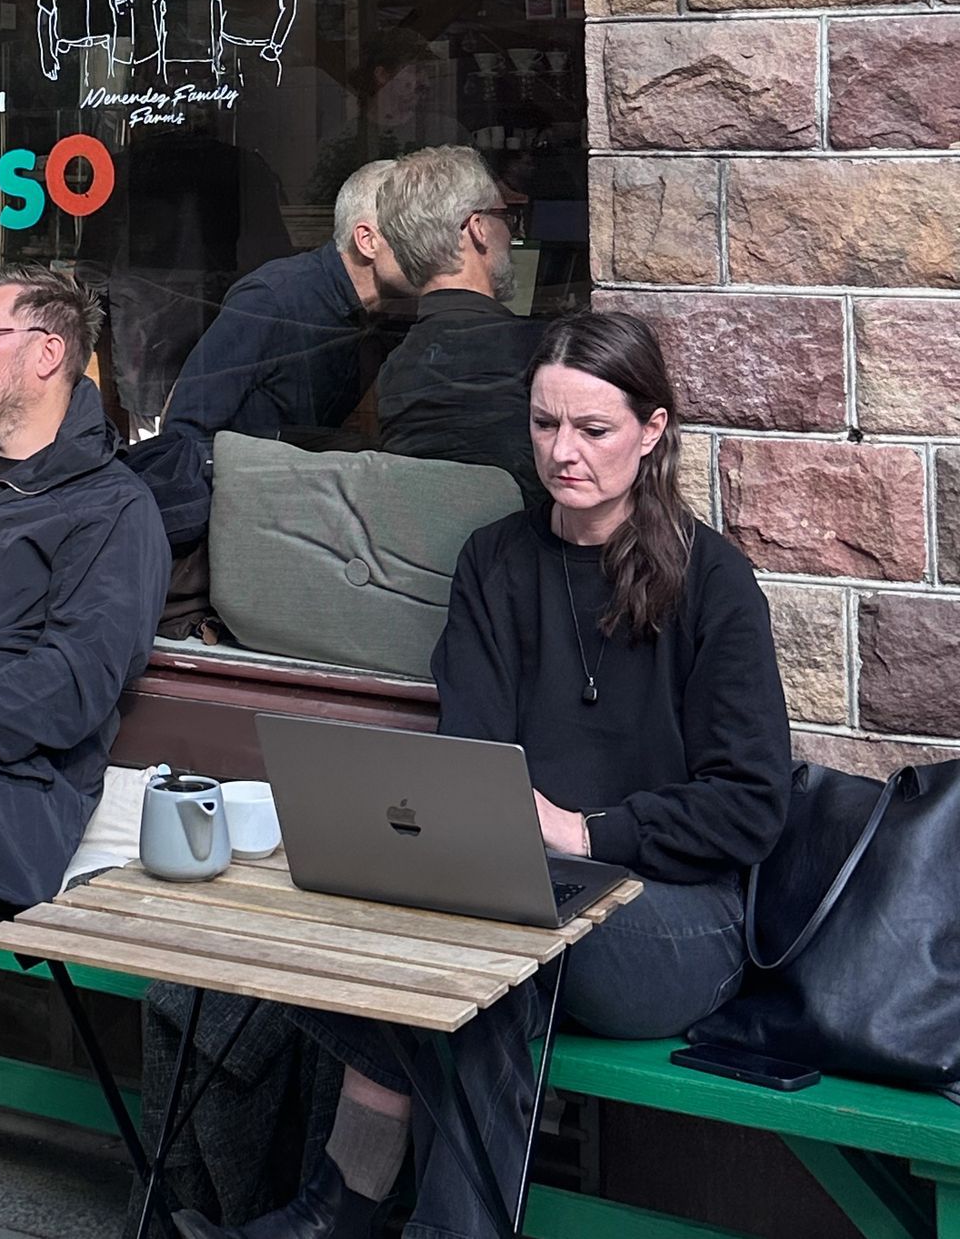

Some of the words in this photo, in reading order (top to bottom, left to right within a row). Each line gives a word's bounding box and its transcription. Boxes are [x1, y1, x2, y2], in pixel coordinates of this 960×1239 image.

[80, 87, 170, 110] Menendez
[172, 84, 240, 109] Family
[129, 106, 186, 129] Farms
